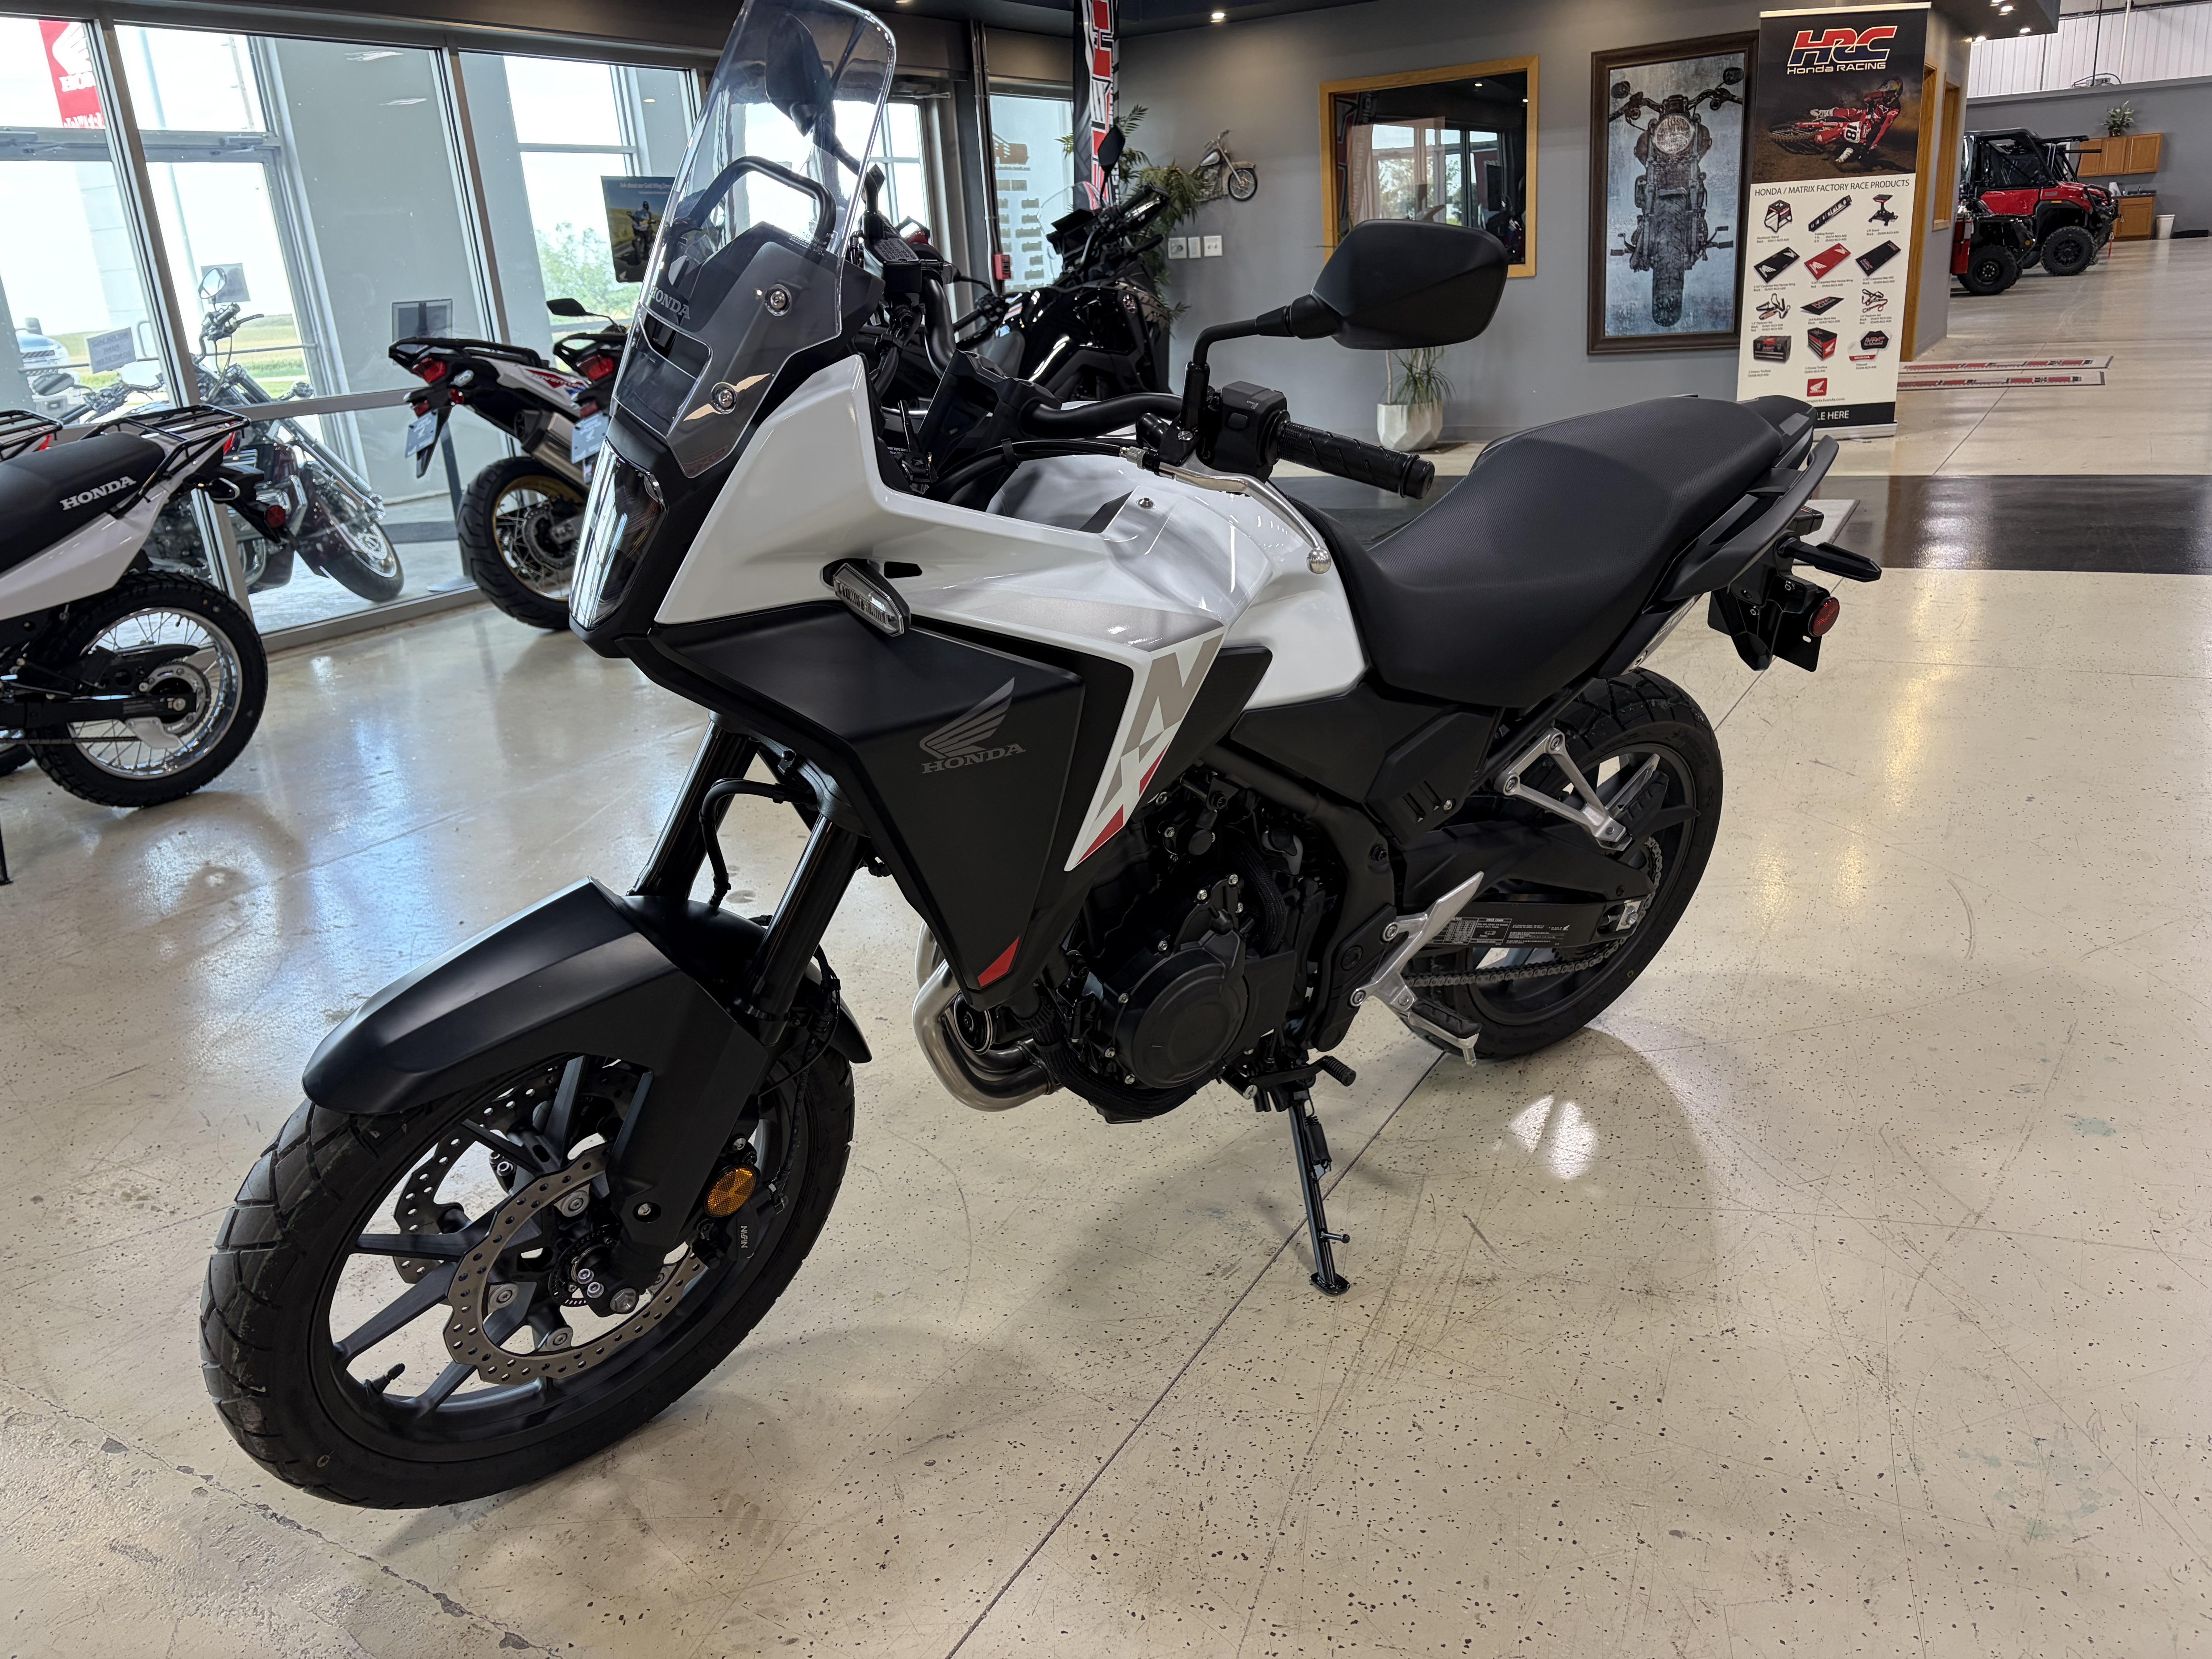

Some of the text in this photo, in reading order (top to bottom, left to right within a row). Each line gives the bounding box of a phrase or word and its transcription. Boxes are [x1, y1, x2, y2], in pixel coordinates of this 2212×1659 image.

[1787, 26, 1898, 67] HRC
[1787, 62, 1886, 74] Honda RACING
[59, 71, 96, 92] HON
[1845, 123, 1859, 141] 18
[1755, 187, 1782, 196] HONDA
[1789, 185, 1815, 194] MATRIX
[1817, 183, 1849, 193] FACTORY
[1851, 181, 1869, 190] RACE
[1870, 179, 1910, 189] PRODUCTS
[650, 285, 691, 320] HONDA
[1827, 410, 1850, 420] HERE
[60, 475, 137, 511] HONDA
[922, 744, 1026, 774] HONDA
